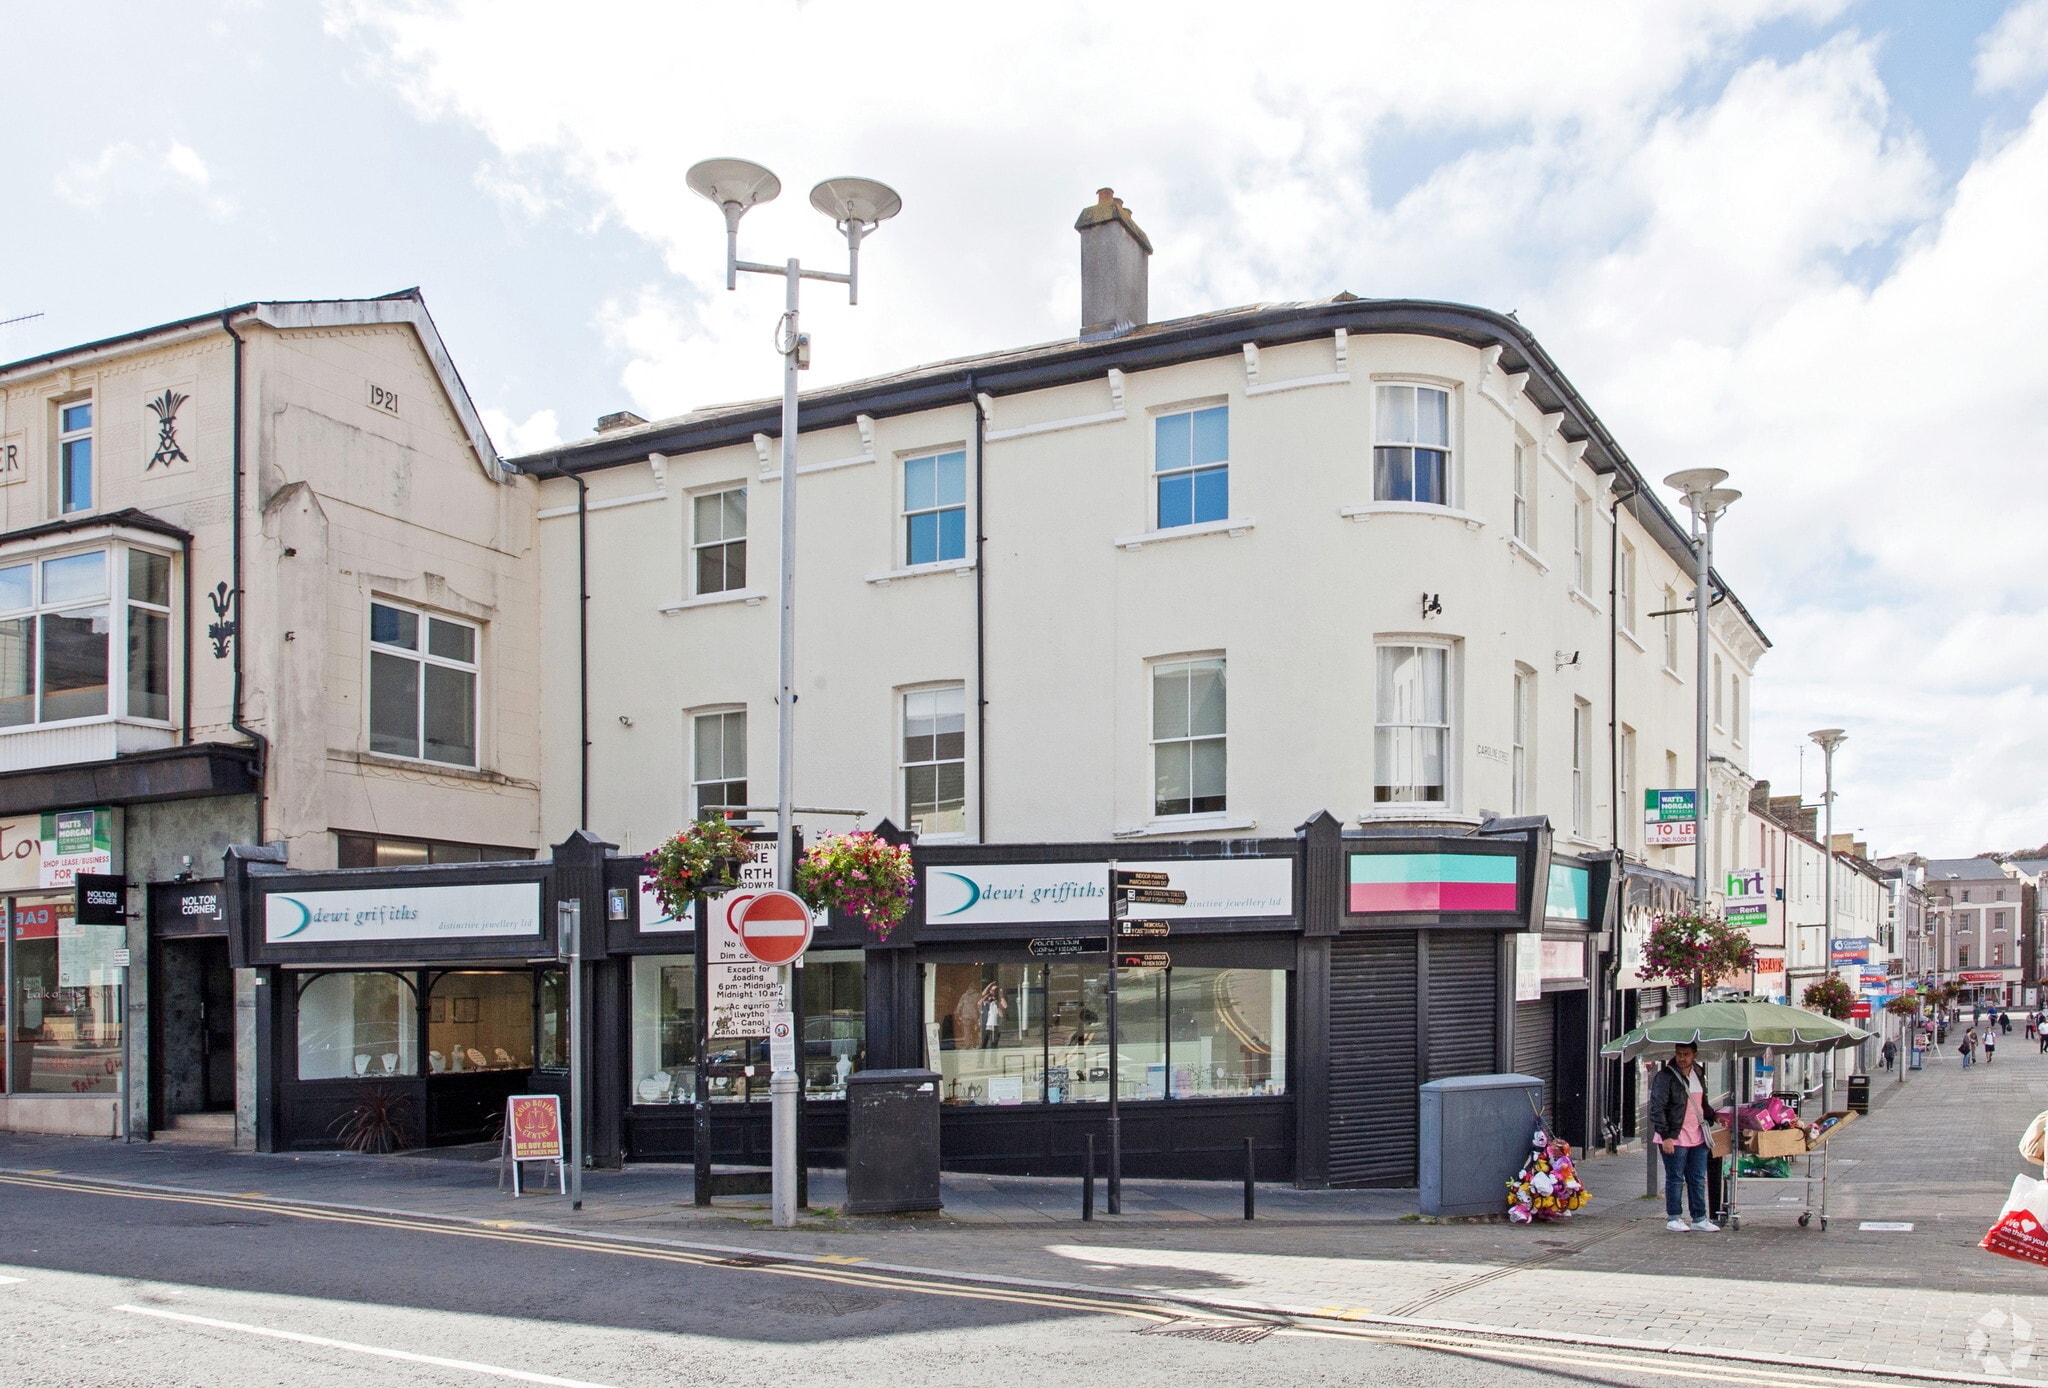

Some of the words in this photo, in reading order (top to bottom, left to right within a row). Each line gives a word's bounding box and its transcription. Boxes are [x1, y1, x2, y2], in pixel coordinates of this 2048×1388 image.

[370, 384, 399, 414] 1921
[0, 445, 19, 472] R
[59, 820, 81, 828] WATTS
[58, 828, 91, 838] MORGAN
[1656, 824, 1673, 836] TO
[1679, 823, 1697, 835] LET
[43, 860, 59, 868] SHOP
[54, 869, 71, 879] FOR
[1727, 871, 1764, 897] hrt
[87, 890, 118, 898] NOLTON
[982, 883, 1025, 900] dewi
[1030, 881, 1105, 904] griffiths
[87, 897, 118, 905] CORNER
[182, 895, 217, 906] NOLTON
[1176, 899, 1222, 909] stinctive
[1223, 898, 1266, 909] jewellery
[182, 904, 216, 915] CORNER
[313, 906, 350, 923] dewi
[438, 920, 480, 931] distinctive
[480, 919, 518, 931] jewellery
[724, 940, 736, 948] No
[720, 952, 736, 960] Dim
[727, 965, 756, 974] Except
[759, 964, 770, 973] for
[716, 990, 753, 999] Midnight
[734, 1010, 765, 1019] llwytho
[741, 1019, 765, 1027] Canol
[715, 1028, 739, 1036] Canol
[515, 1101, 531, 1117] GOLD
[532, 1099, 557, 1117] BUYING
[1781, 1099, 1798, 1109] ALE
[522, 1129, 551, 1140] CENTRE
[542, 1141, 558, 1149] GOLD
[2012, 1229, 2032, 1242] things
[2032, 1237, 2045, 1246] you
